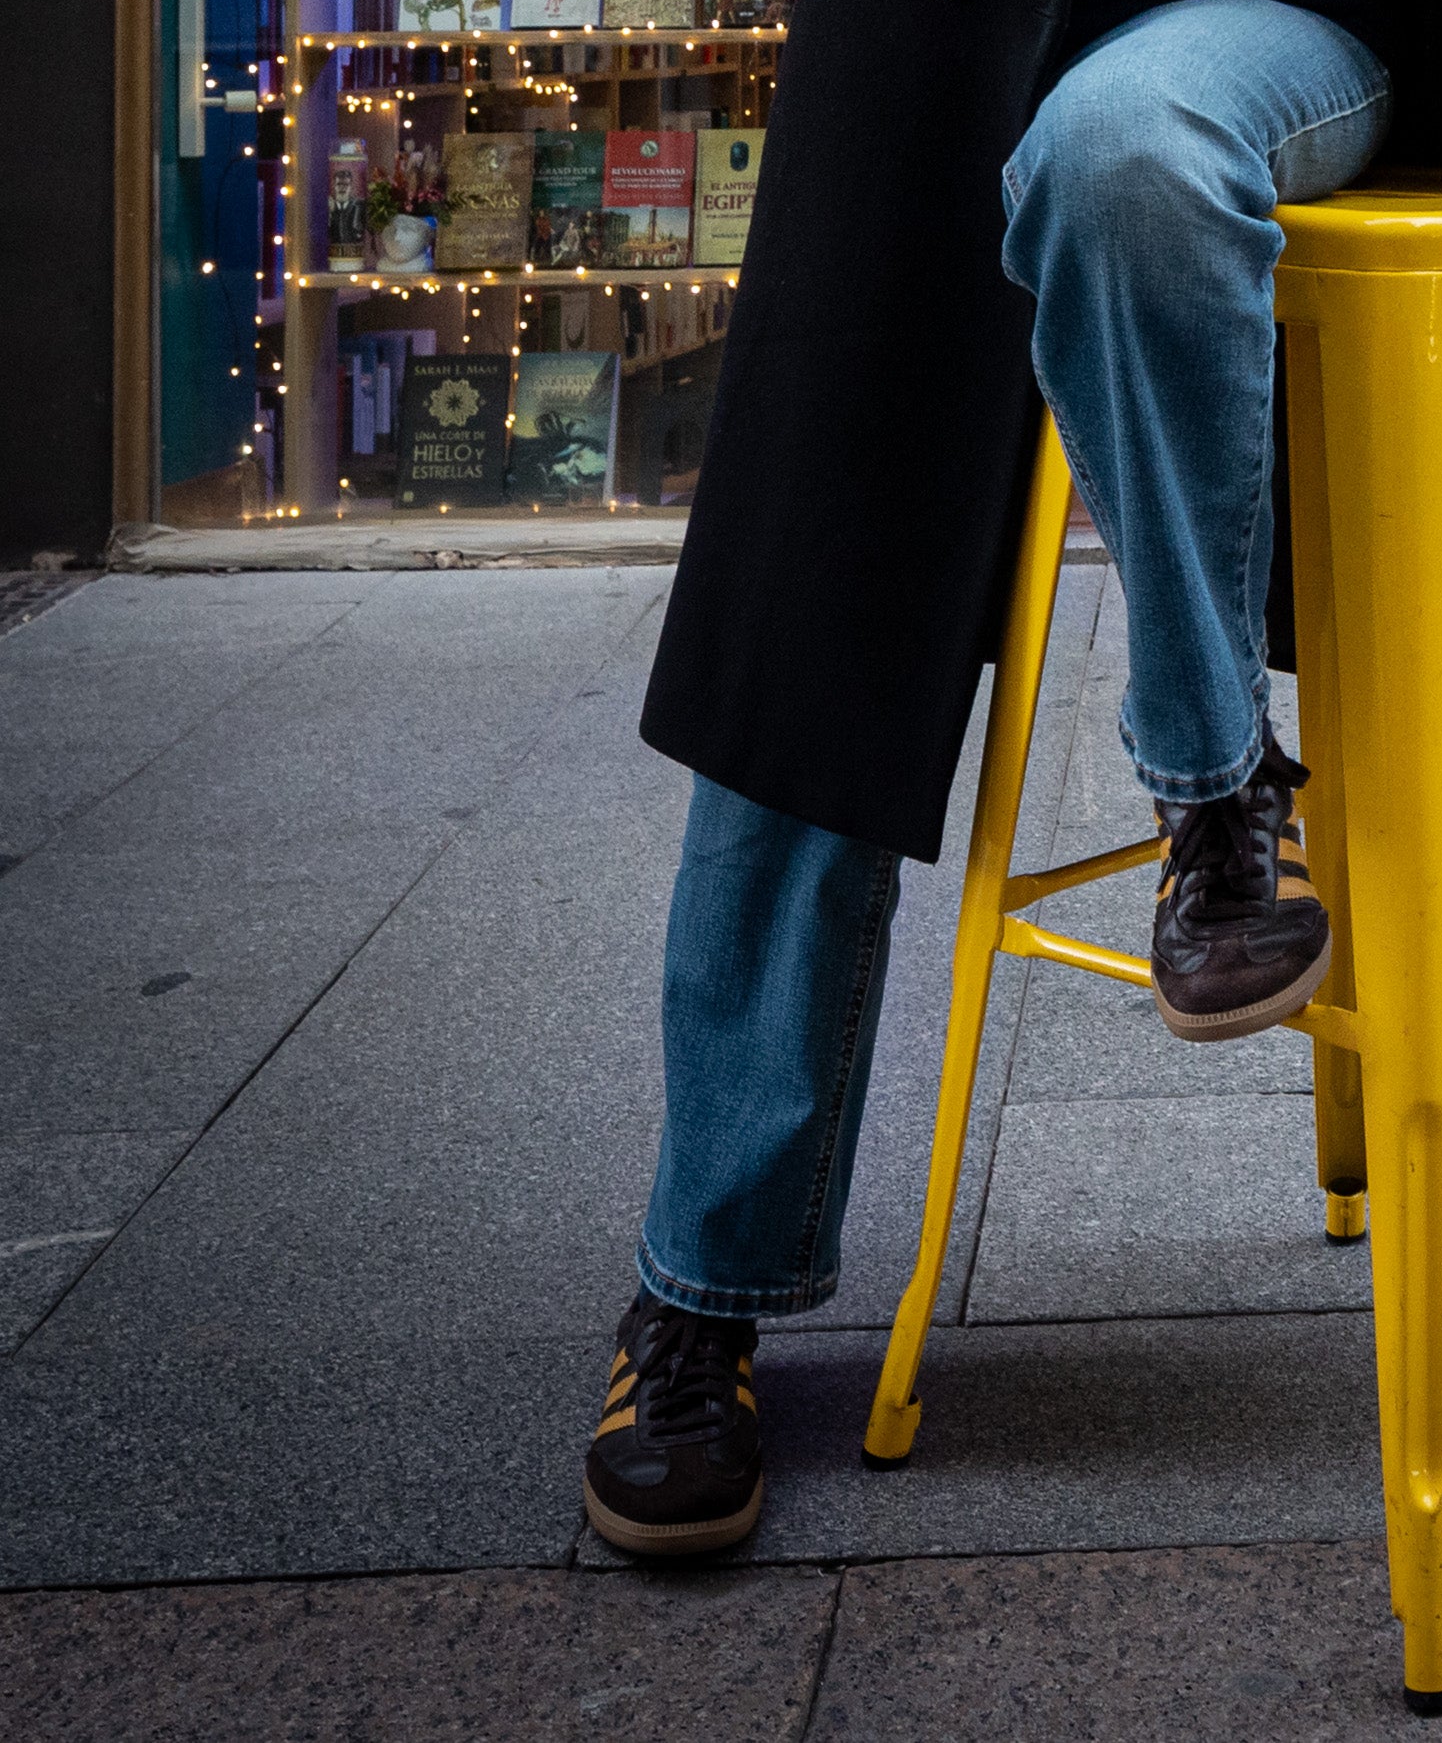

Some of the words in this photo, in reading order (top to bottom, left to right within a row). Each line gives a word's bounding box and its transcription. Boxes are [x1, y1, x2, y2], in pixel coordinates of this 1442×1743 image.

[711, 182, 722, 191] EL
[413, 366, 450, 376] SARAH
[467, 366, 498, 375] MAAS
[414, 431, 437, 441] UNA
[440, 431, 469, 440] CORTE
[473, 431, 485, 440] DE
[413, 443, 471, 462] HIELO
[475, 448, 485, 459] Y
[412, 464, 484, 479] ESTRELLAS
